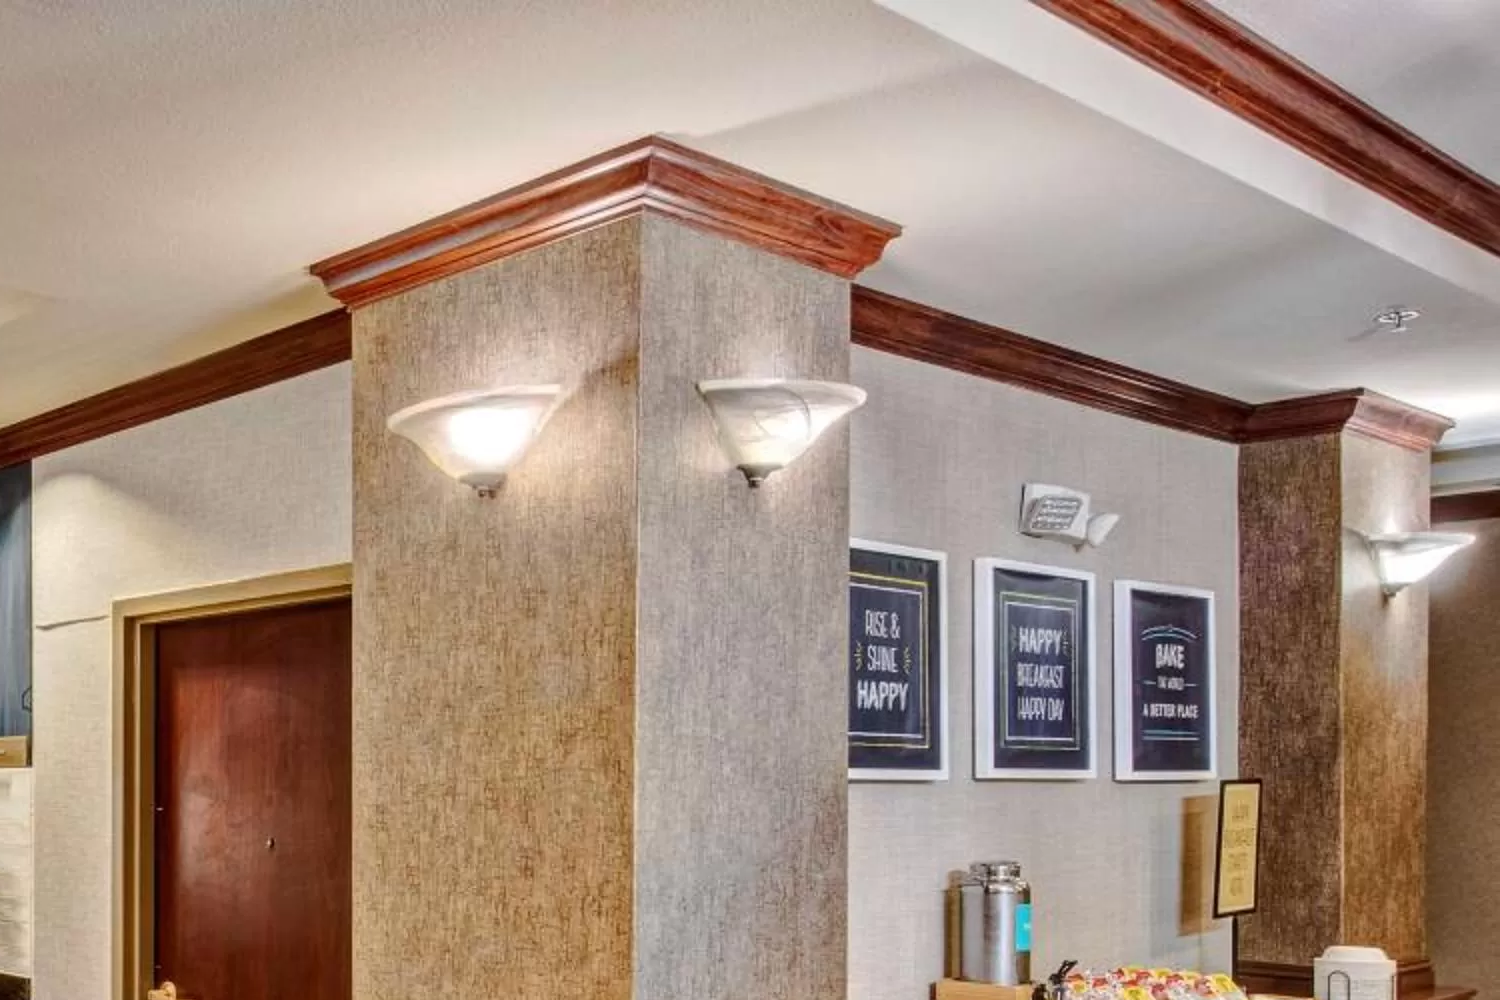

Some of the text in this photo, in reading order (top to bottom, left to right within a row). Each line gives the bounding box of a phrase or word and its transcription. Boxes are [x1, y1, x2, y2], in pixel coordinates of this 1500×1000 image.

[865, 609, 900, 639] RISE &
[1019, 626, 1062, 656] HAPPY
[867, 643, 899, 673] SHINE
[1155, 643, 1185, 669] BAKE
[1016, 662, 1065, 689] BREAKFAST
[857, 679, 908, 712] HAPPY
[1017, 695, 1065, 721] HAPPY DAY
[1142, 703, 1199, 718] A BETTER PLACE
